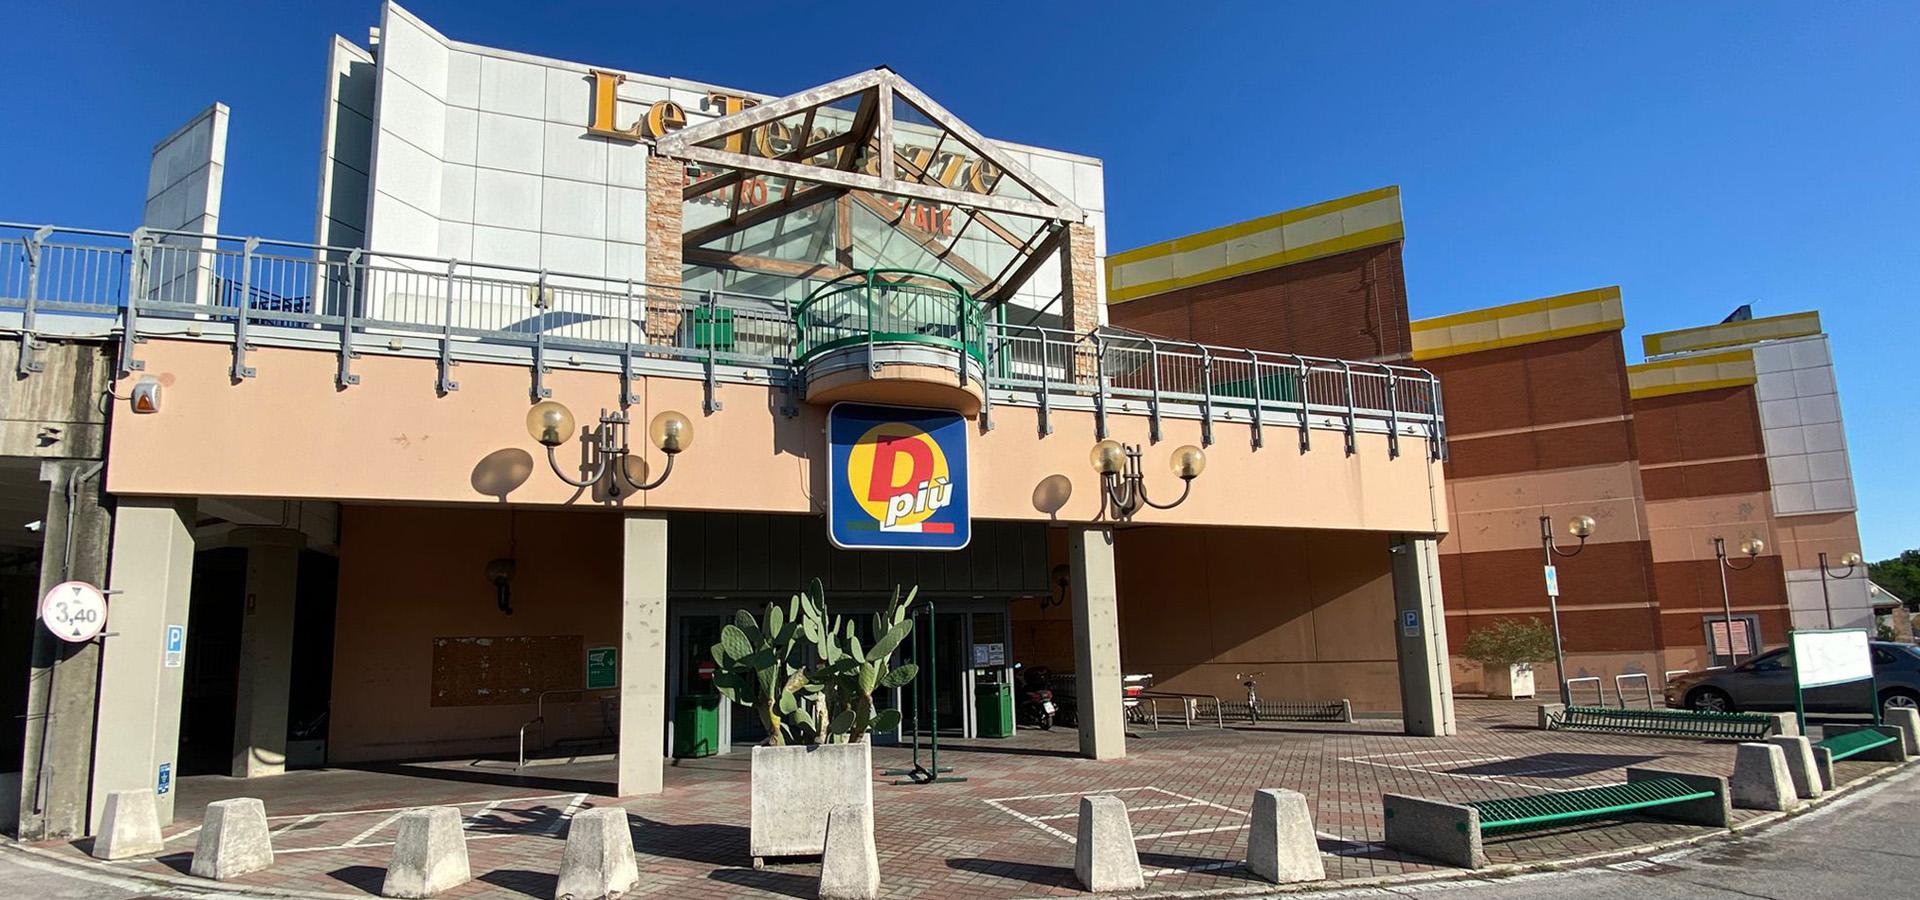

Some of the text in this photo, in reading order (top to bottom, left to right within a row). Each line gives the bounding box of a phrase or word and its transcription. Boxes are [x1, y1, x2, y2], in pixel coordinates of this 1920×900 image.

[587, 69, 1001, 196] Le Tezze
[868, 435, 954, 528] D più
[56, 602, 97, 626] 3,40
[1406, 613, 1416, 626] P
[170, 629, 180, 650] P
